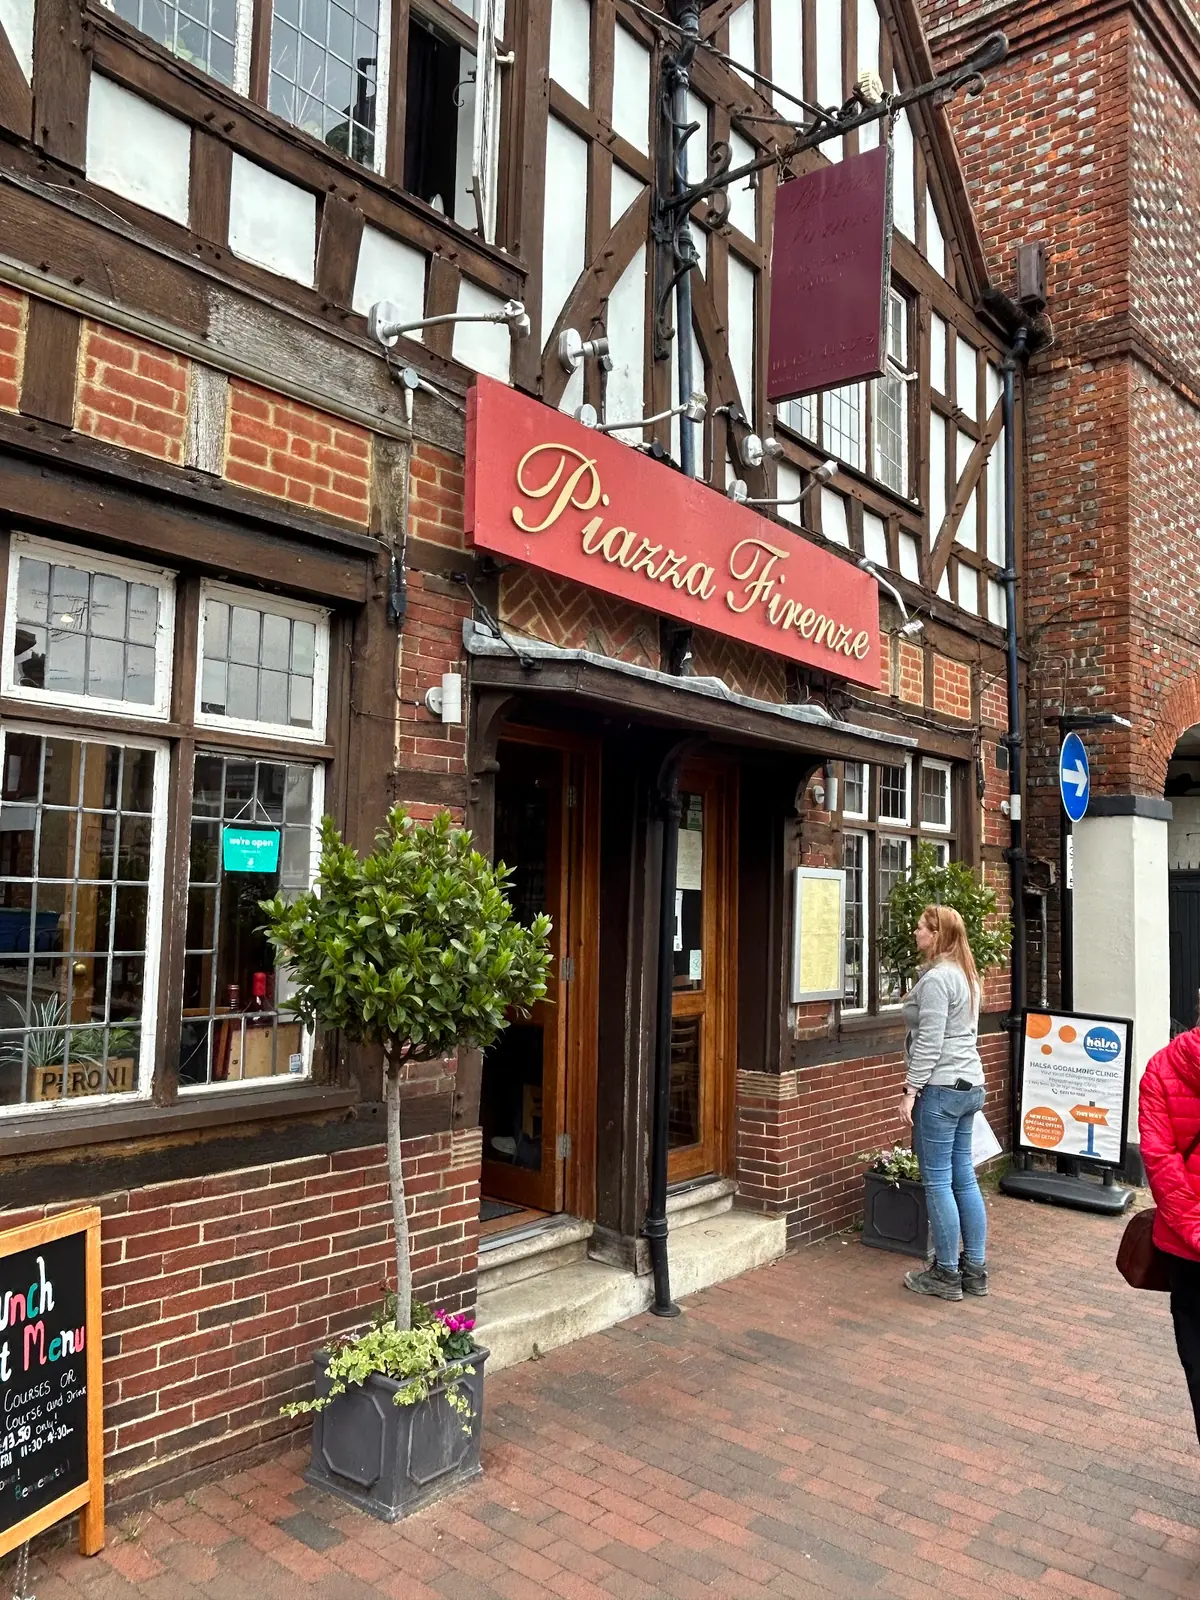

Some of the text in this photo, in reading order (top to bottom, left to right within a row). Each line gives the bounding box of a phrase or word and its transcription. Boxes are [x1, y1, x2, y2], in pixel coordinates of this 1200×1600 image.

[511, 442, 871, 661] Piazza Firenze
[229, 836, 274, 849] we're open
[41, 1067, 127, 1095] PERONI
[1095, 1068, 1119, 1079] CLINIC
[24, 1320, 85, 1372] Menu
[60, 1369, 77, 1388] OR
[46, 1392, 63, 1413] and
